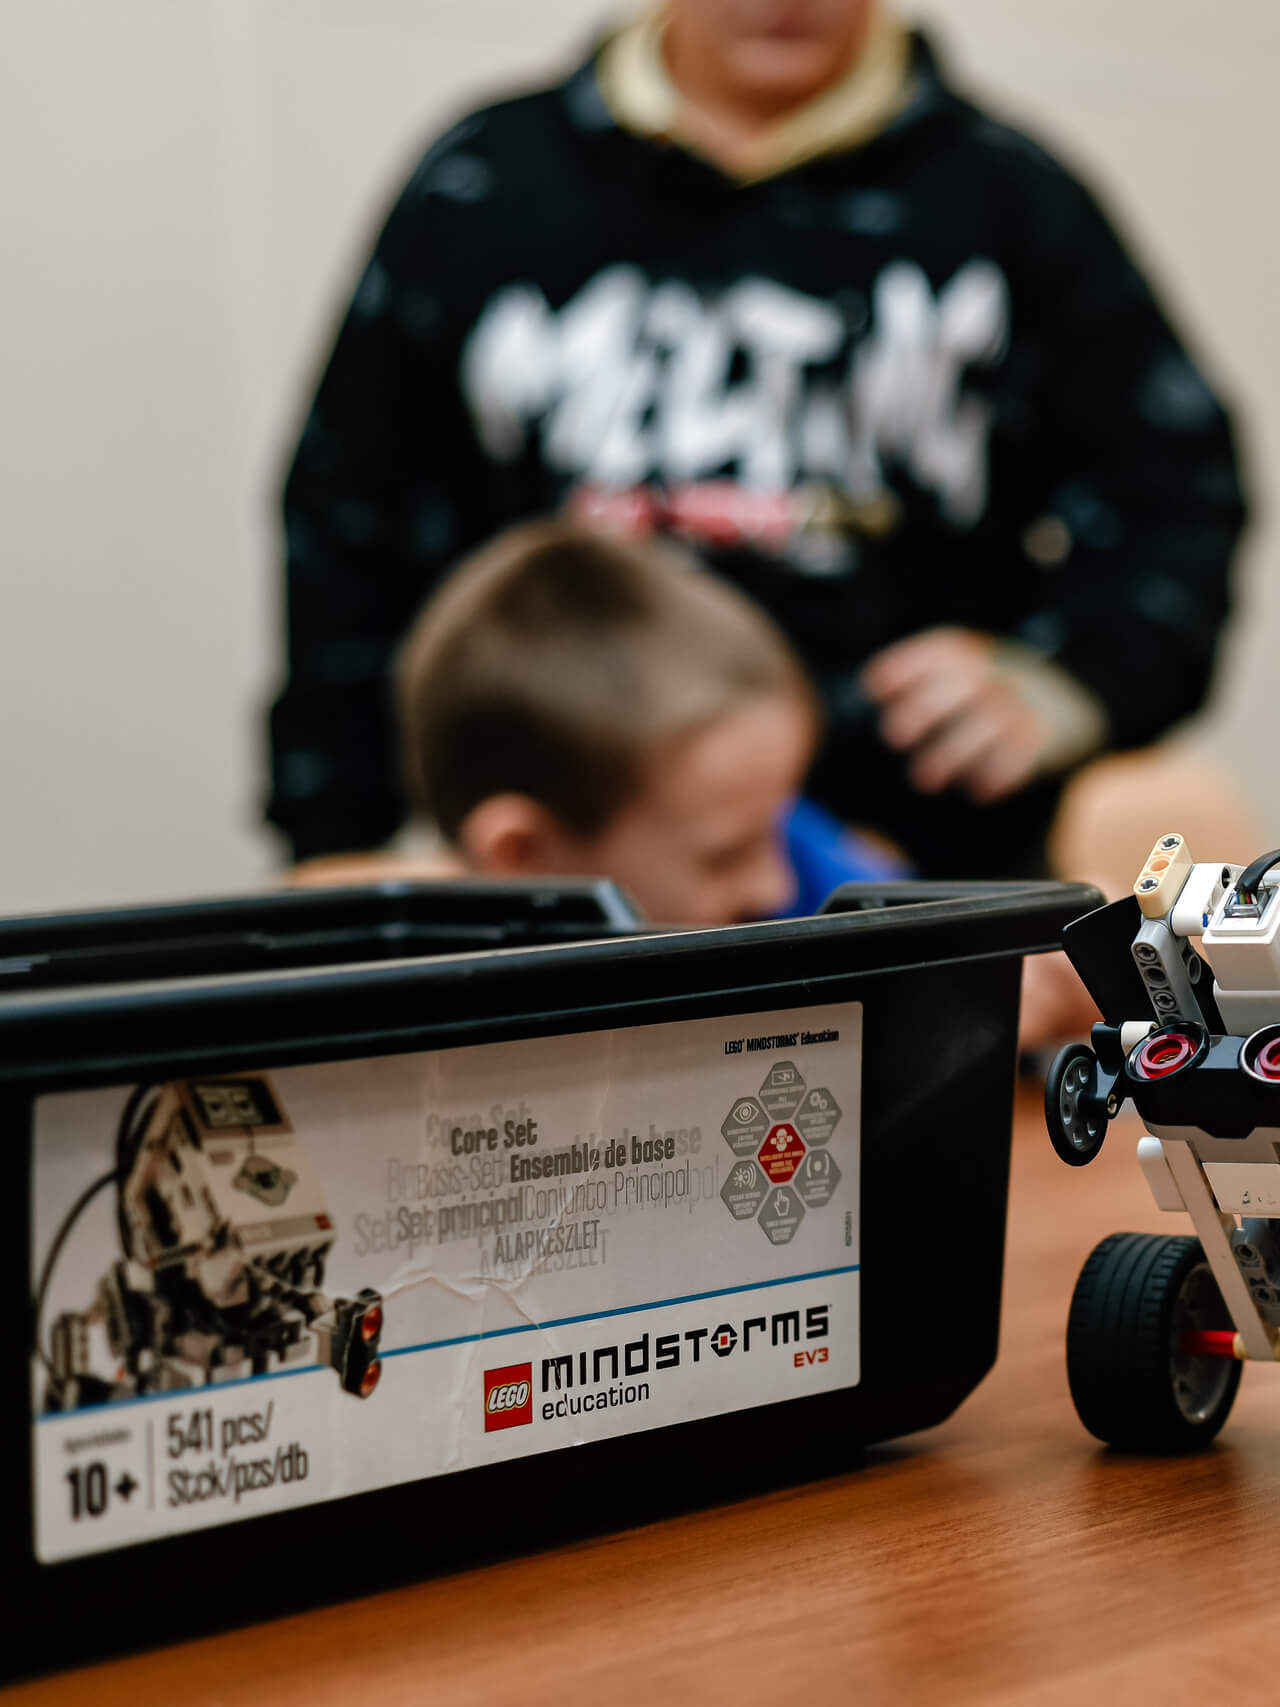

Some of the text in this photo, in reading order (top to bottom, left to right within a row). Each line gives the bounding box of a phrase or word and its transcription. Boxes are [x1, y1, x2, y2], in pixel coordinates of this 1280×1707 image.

[450, 1118, 538, 1156] Core Set
[510, 1135, 676, 1183] Ensemble de base
[614, 1158, 690, 1208] Principal
[793, 1346, 830, 1369] EV3
[486, 1381, 532, 1414] LEGO
[541, 1382, 651, 1421] education
[167, 1408, 214, 1459] 541
